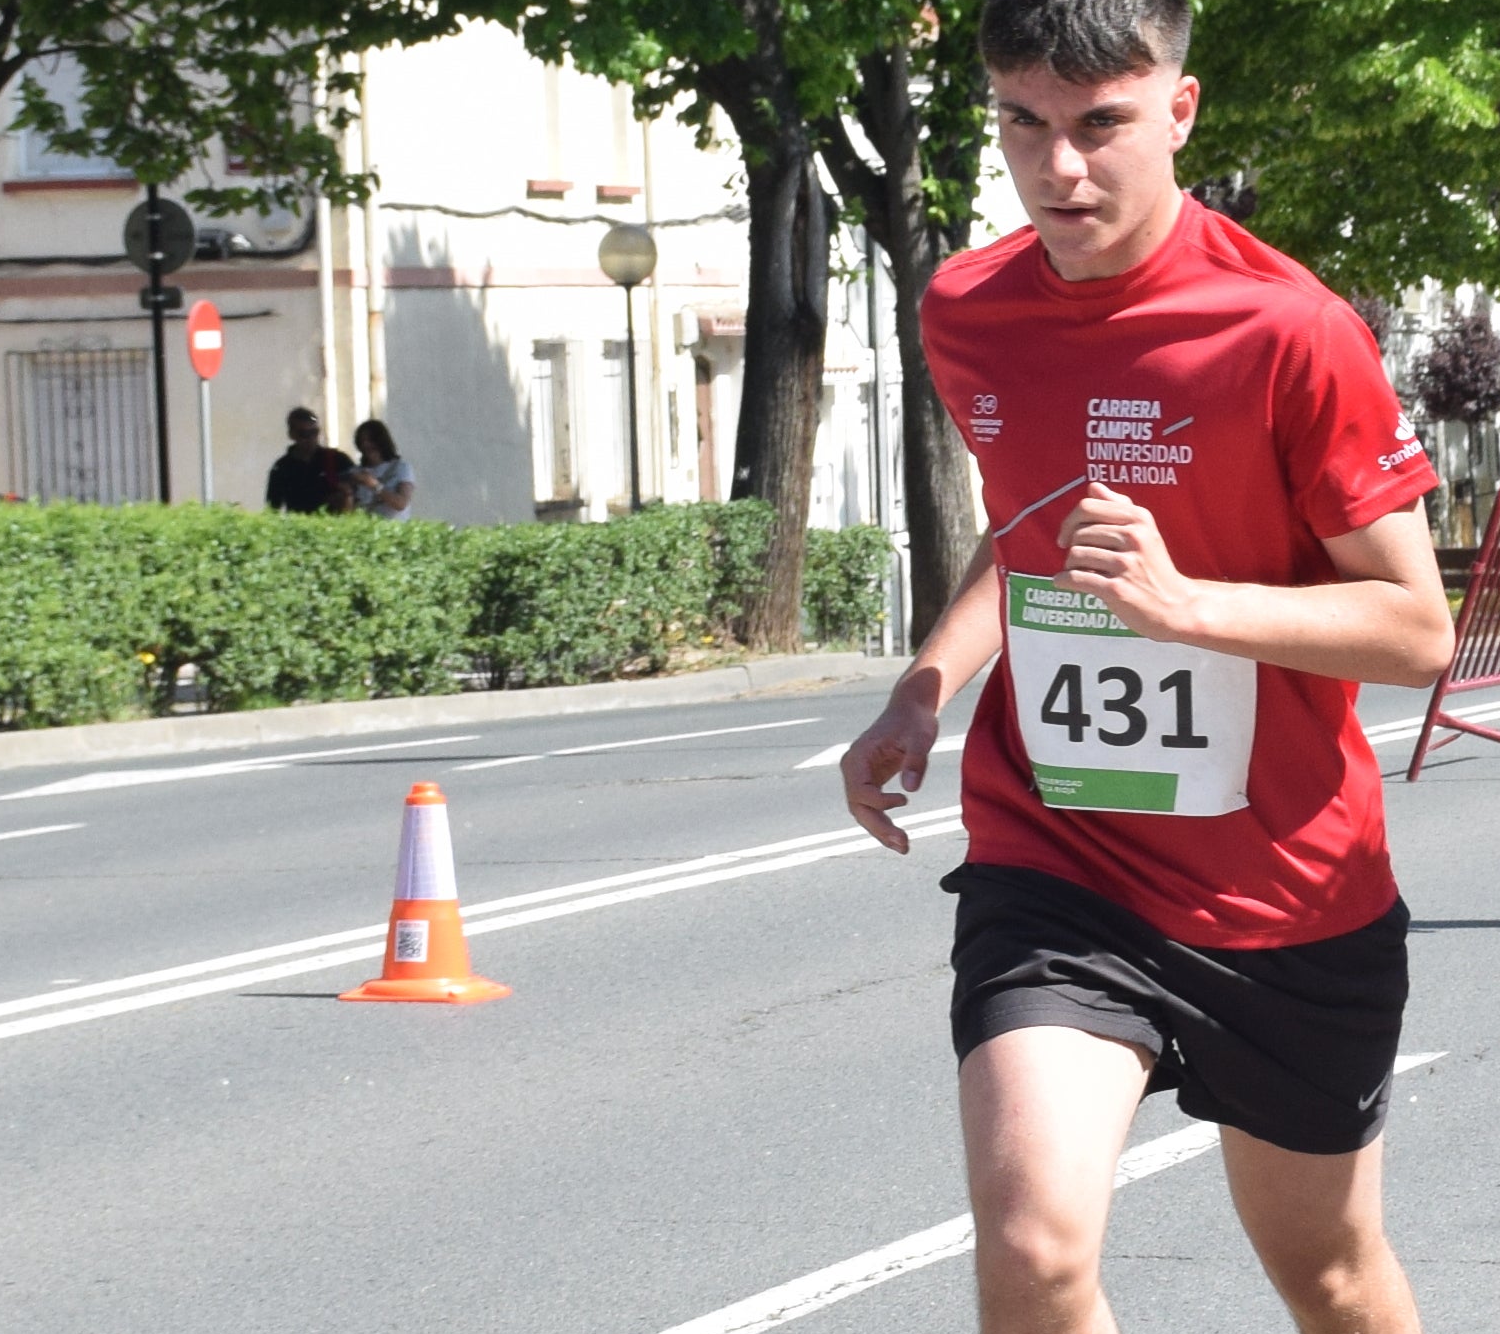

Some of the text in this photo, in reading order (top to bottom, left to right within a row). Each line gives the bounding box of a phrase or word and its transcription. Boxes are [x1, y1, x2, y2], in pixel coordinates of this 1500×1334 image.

[1087, 398, 1162, 419] CARRERA
[1086, 420, 1153, 441] CAMPUS
[1086, 442, 1193, 464] UNIVERSIDAD
[1087, 464, 1178, 485] DE LA RIOJA
[1025, 587, 1082, 609] CARRERA
[1022, 605, 1109, 629] UNIVERSIDAD
[1041, 663, 1209, 749] 431
